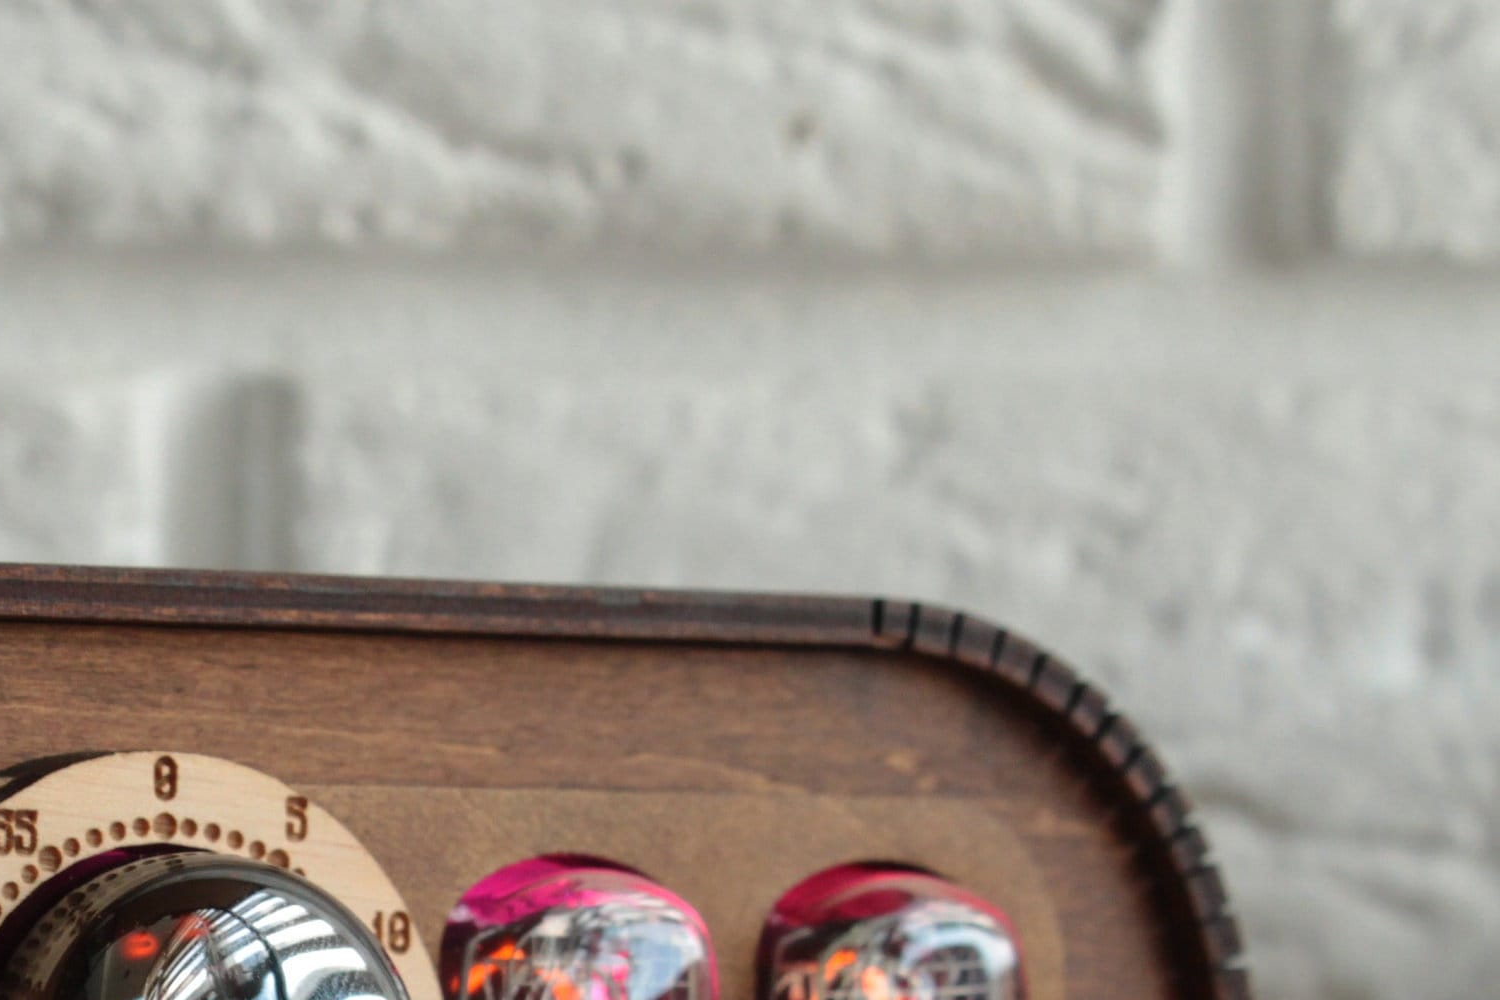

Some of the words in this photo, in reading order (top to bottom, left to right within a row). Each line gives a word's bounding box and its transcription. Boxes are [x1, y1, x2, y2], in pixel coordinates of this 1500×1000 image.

[153, 755, 178, 799] 0
[284, 796, 308, 840] 5
[372, 910, 411, 953] 10
